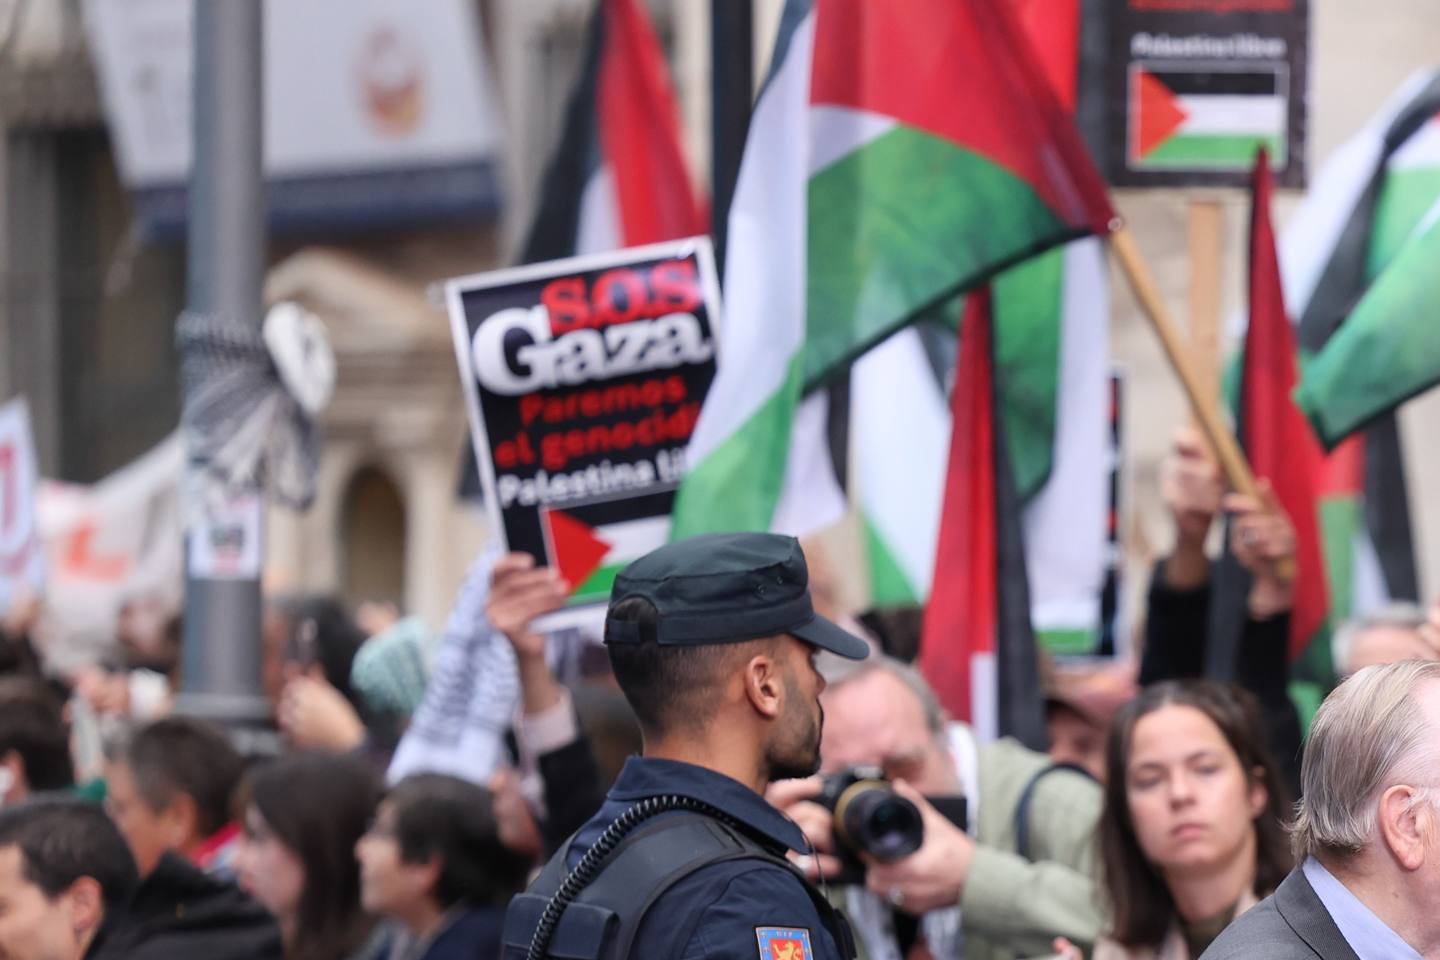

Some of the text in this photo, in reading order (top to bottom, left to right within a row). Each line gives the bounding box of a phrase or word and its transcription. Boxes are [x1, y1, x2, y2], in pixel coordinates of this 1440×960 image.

[519, 375, 688, 427] Paremos
[495, 403, 701, 472] el genocid
[498, 460, 657, 508] Palestina
